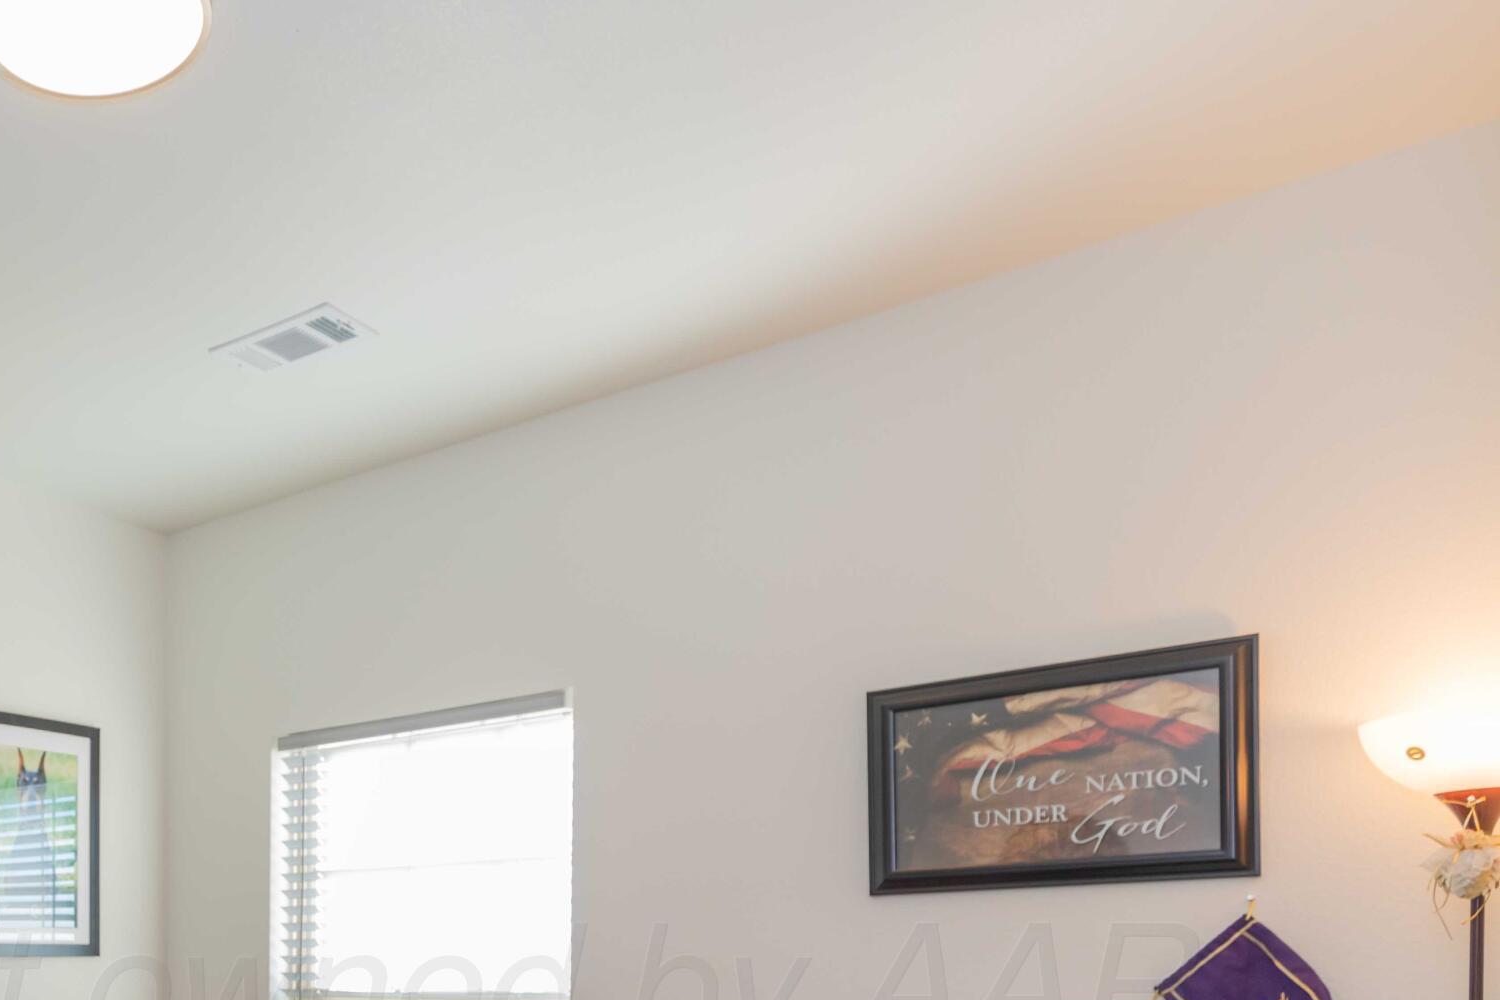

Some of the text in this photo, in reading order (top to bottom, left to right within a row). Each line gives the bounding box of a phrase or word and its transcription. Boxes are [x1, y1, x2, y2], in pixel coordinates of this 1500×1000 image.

[971, 754, 1209, 801] One NATION,
[973, 794, 1187, 854] UNDER God
